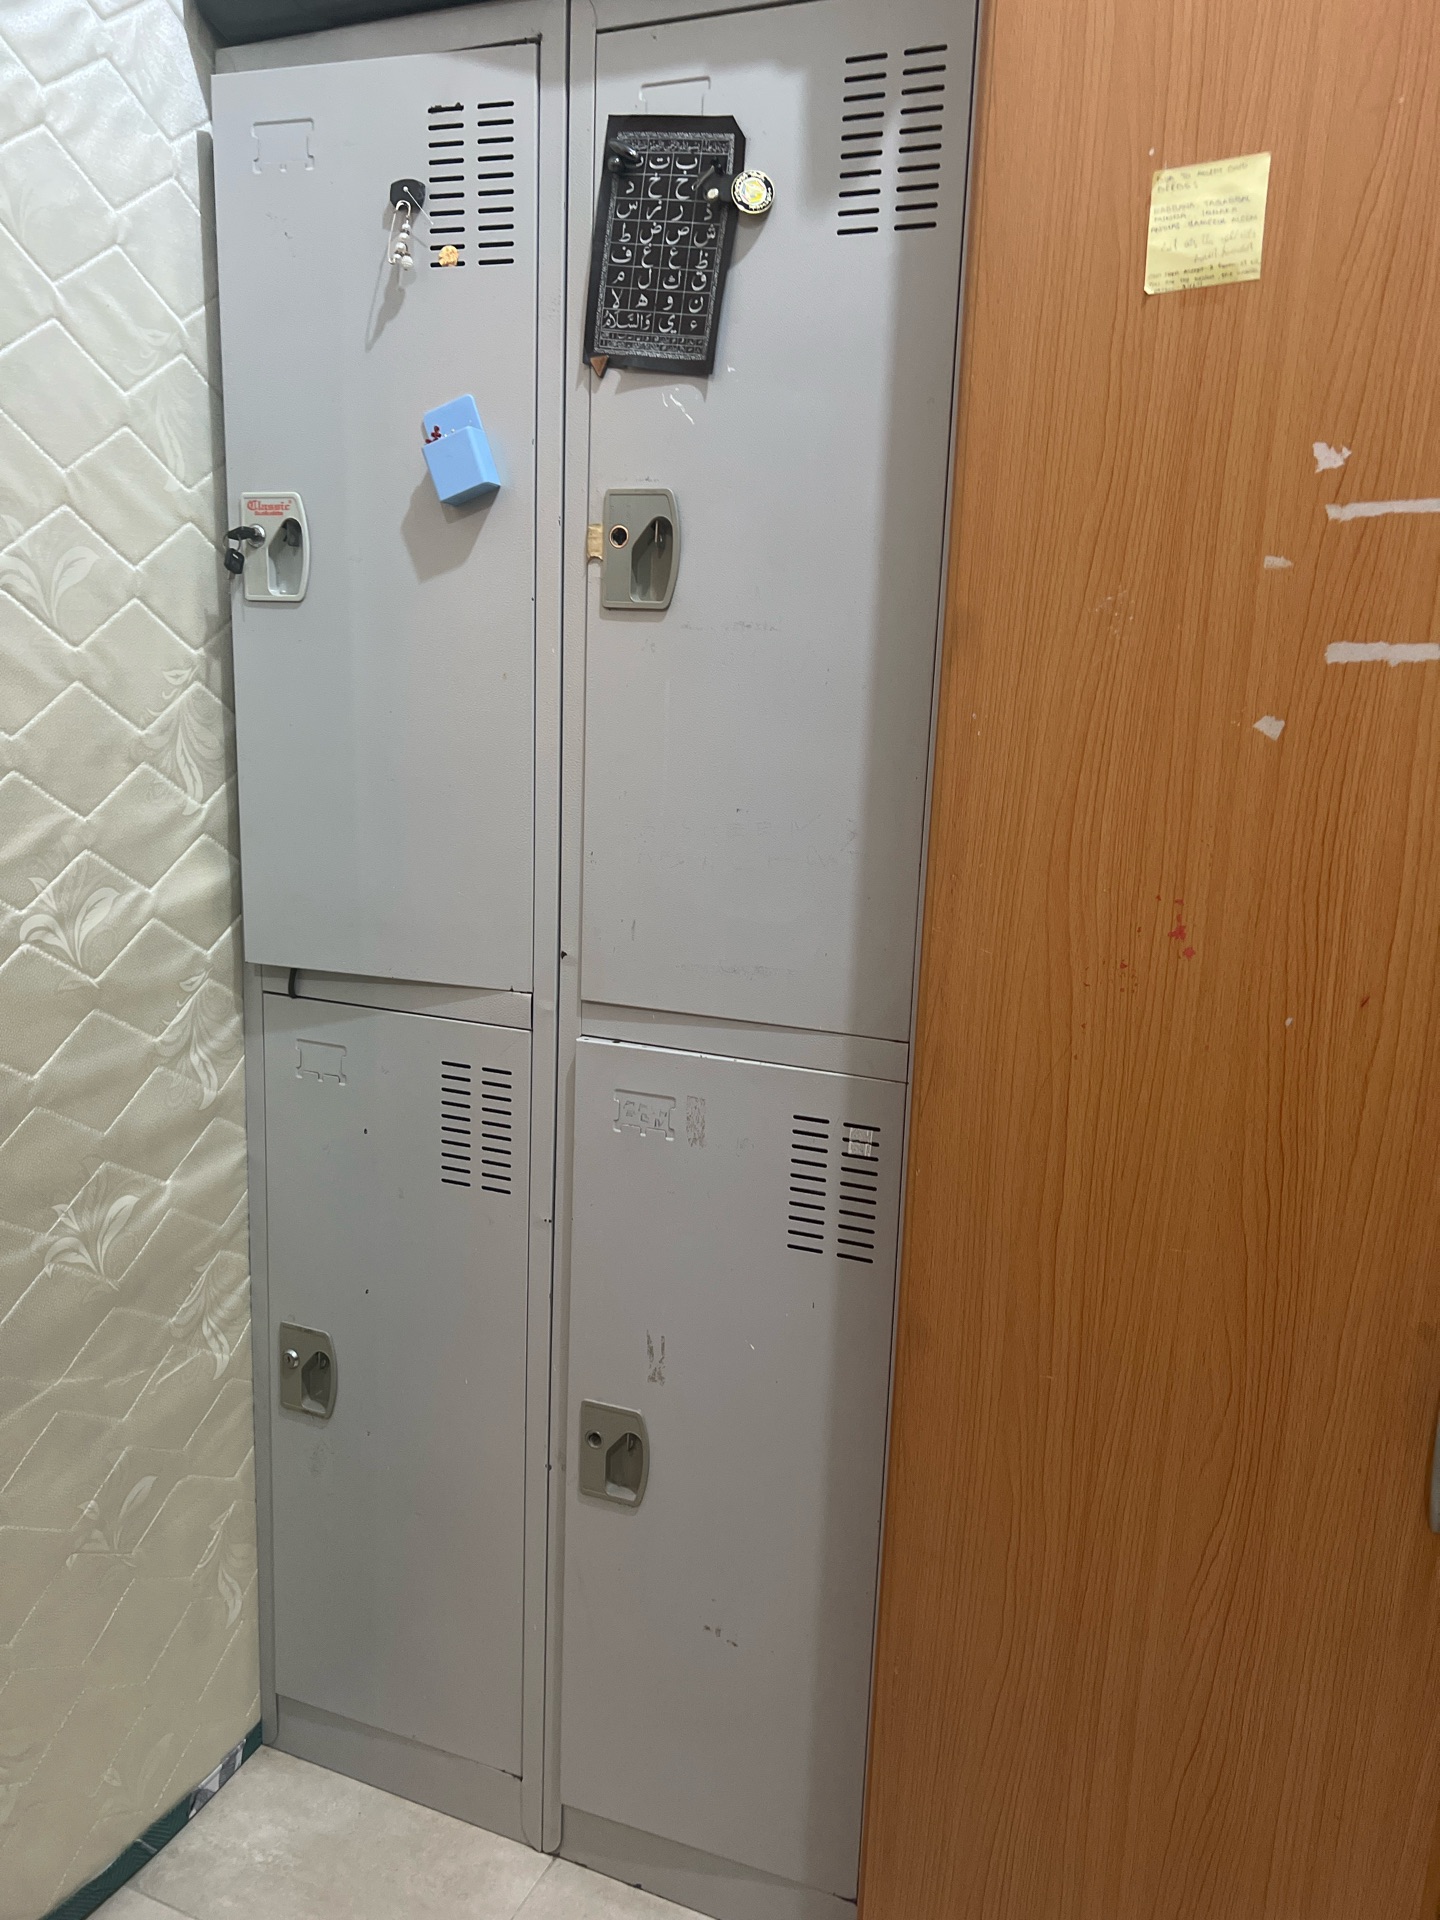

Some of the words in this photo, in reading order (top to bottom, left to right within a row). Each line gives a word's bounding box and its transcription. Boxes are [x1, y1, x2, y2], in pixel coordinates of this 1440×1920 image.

[648, 156, 671, 170] ت
[675, 156, 698, 175] ب
[626, 179, 637, 194] د
[647, 173, 663, 199] خ
[675, 176, 691, 200] ح
[616, 200, 638, 219] س
[646, 200, 663, 220] ز
[671, 204, 684, 222] ر
[703, 202, 714, 221] ذ
[619, 223, 632, 243] ط
[639, 222, 662, 243] ض
[666, 225, 691, 245] ص
[693, 222, 716, 246] ش
[611, 245, 632, 264] ف
[641, 243, 656, 267] غ
[669, 247, 682, 269] ع
[695, 250, 709, 268] ظ
[612, 271, 626, 286] م
[637, 268, 652, 289] ل
[662, 270, 682, 290] ك
[691, 270, 707, 291] ق
[612, 289, 623, 310] لا
[663, 295, 674, 311] و
[688, 295, 704, 313] ن
[247, 500, 291, 511] Classic
